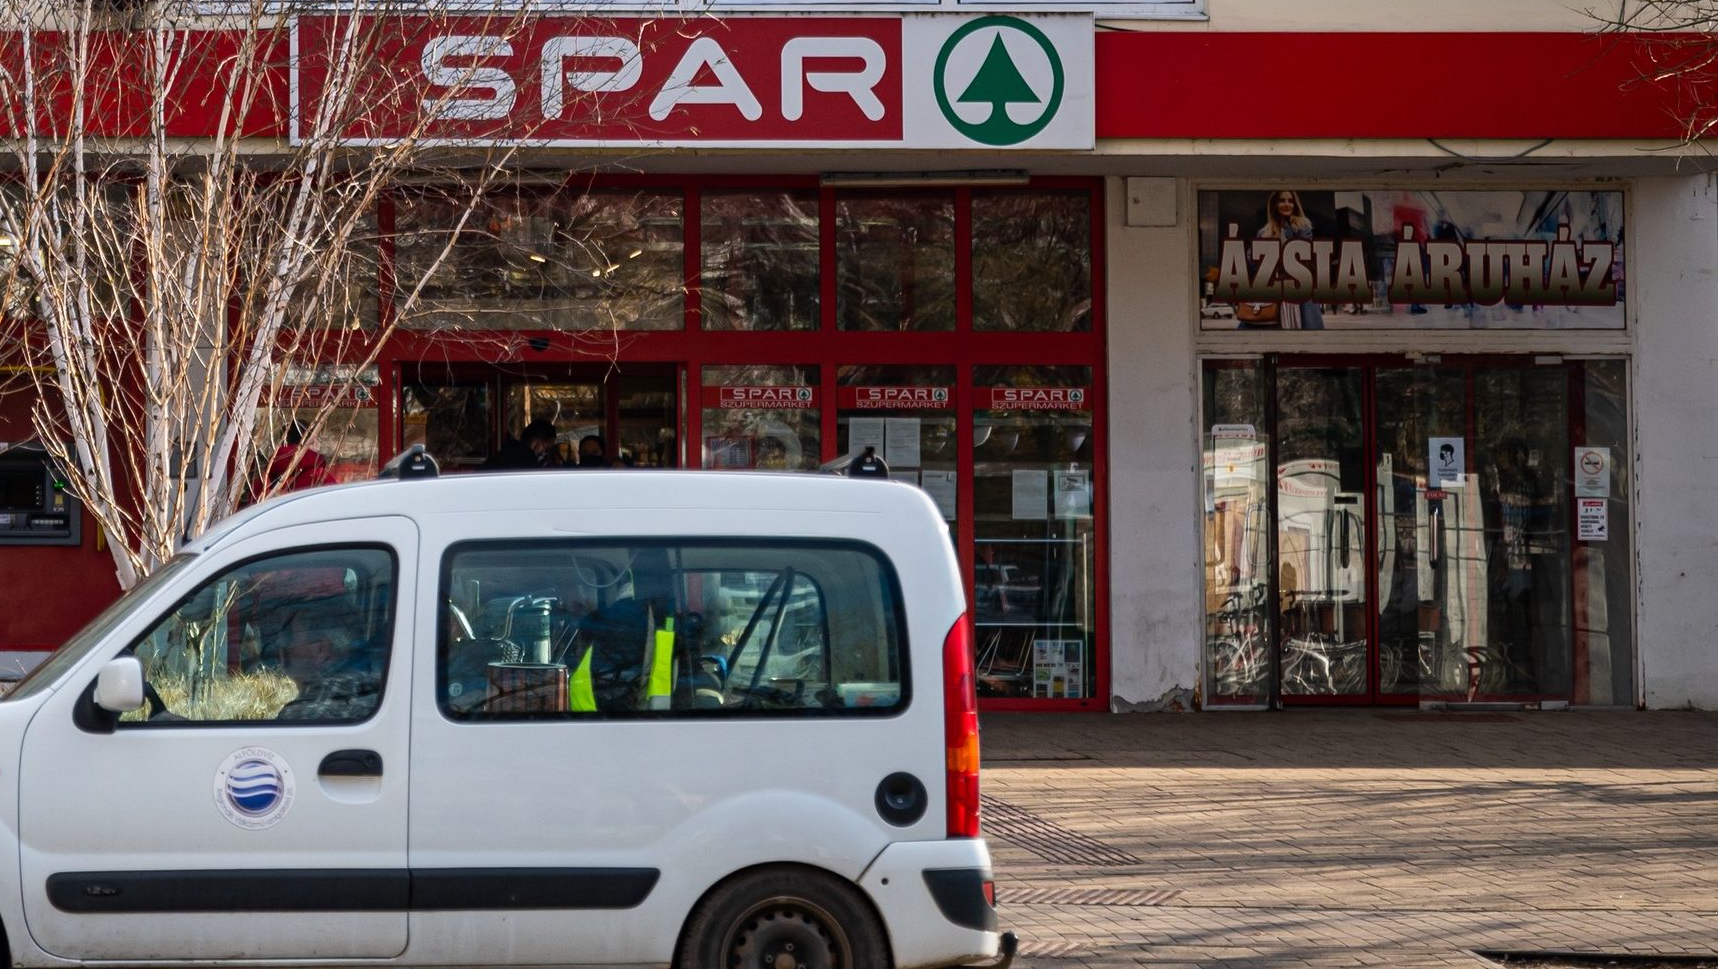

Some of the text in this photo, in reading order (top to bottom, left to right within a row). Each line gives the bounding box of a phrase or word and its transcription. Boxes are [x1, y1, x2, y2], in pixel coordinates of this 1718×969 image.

[420, 35, 886, 122] SPAR
[1213, 221, 1617, 307] ÁZSIA ÁRUHÁZ
[733, 389, 792, 399] SPAR
[869, 389, 928, 400] SPAR
[1004, 390, 1064, 401] SPAR
[720, 401, 812, 409] SZUPERMARKET
[856, 401, 947, 409] SZUPERMARKET
[991, 401, 1083, 410] SZUPERMARKET
